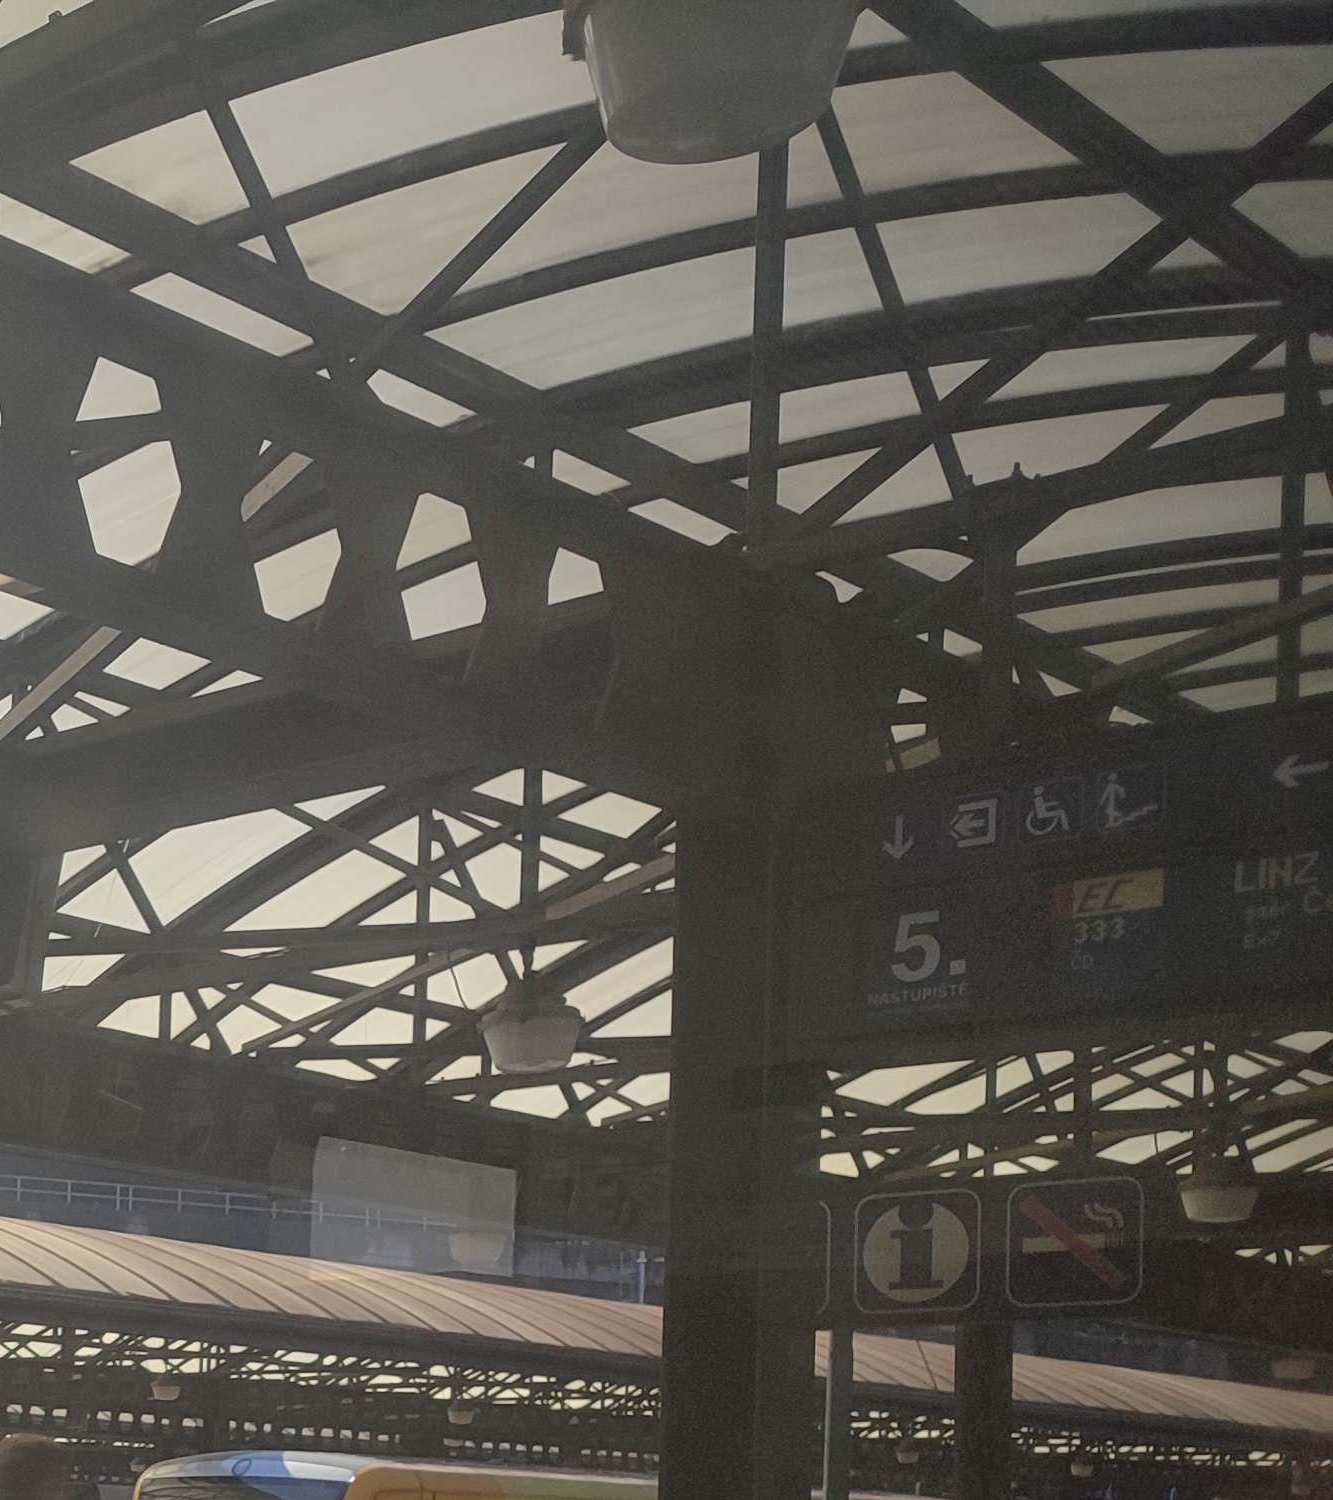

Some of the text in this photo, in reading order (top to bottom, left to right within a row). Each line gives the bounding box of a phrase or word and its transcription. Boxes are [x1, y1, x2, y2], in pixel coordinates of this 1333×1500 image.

[1234, 850, 1320, 893] LINZ
[1076, 877, 1135, 914] EC
[890, 908, 967, 983] 5.
[1073, 916, 1126, 944] 333
